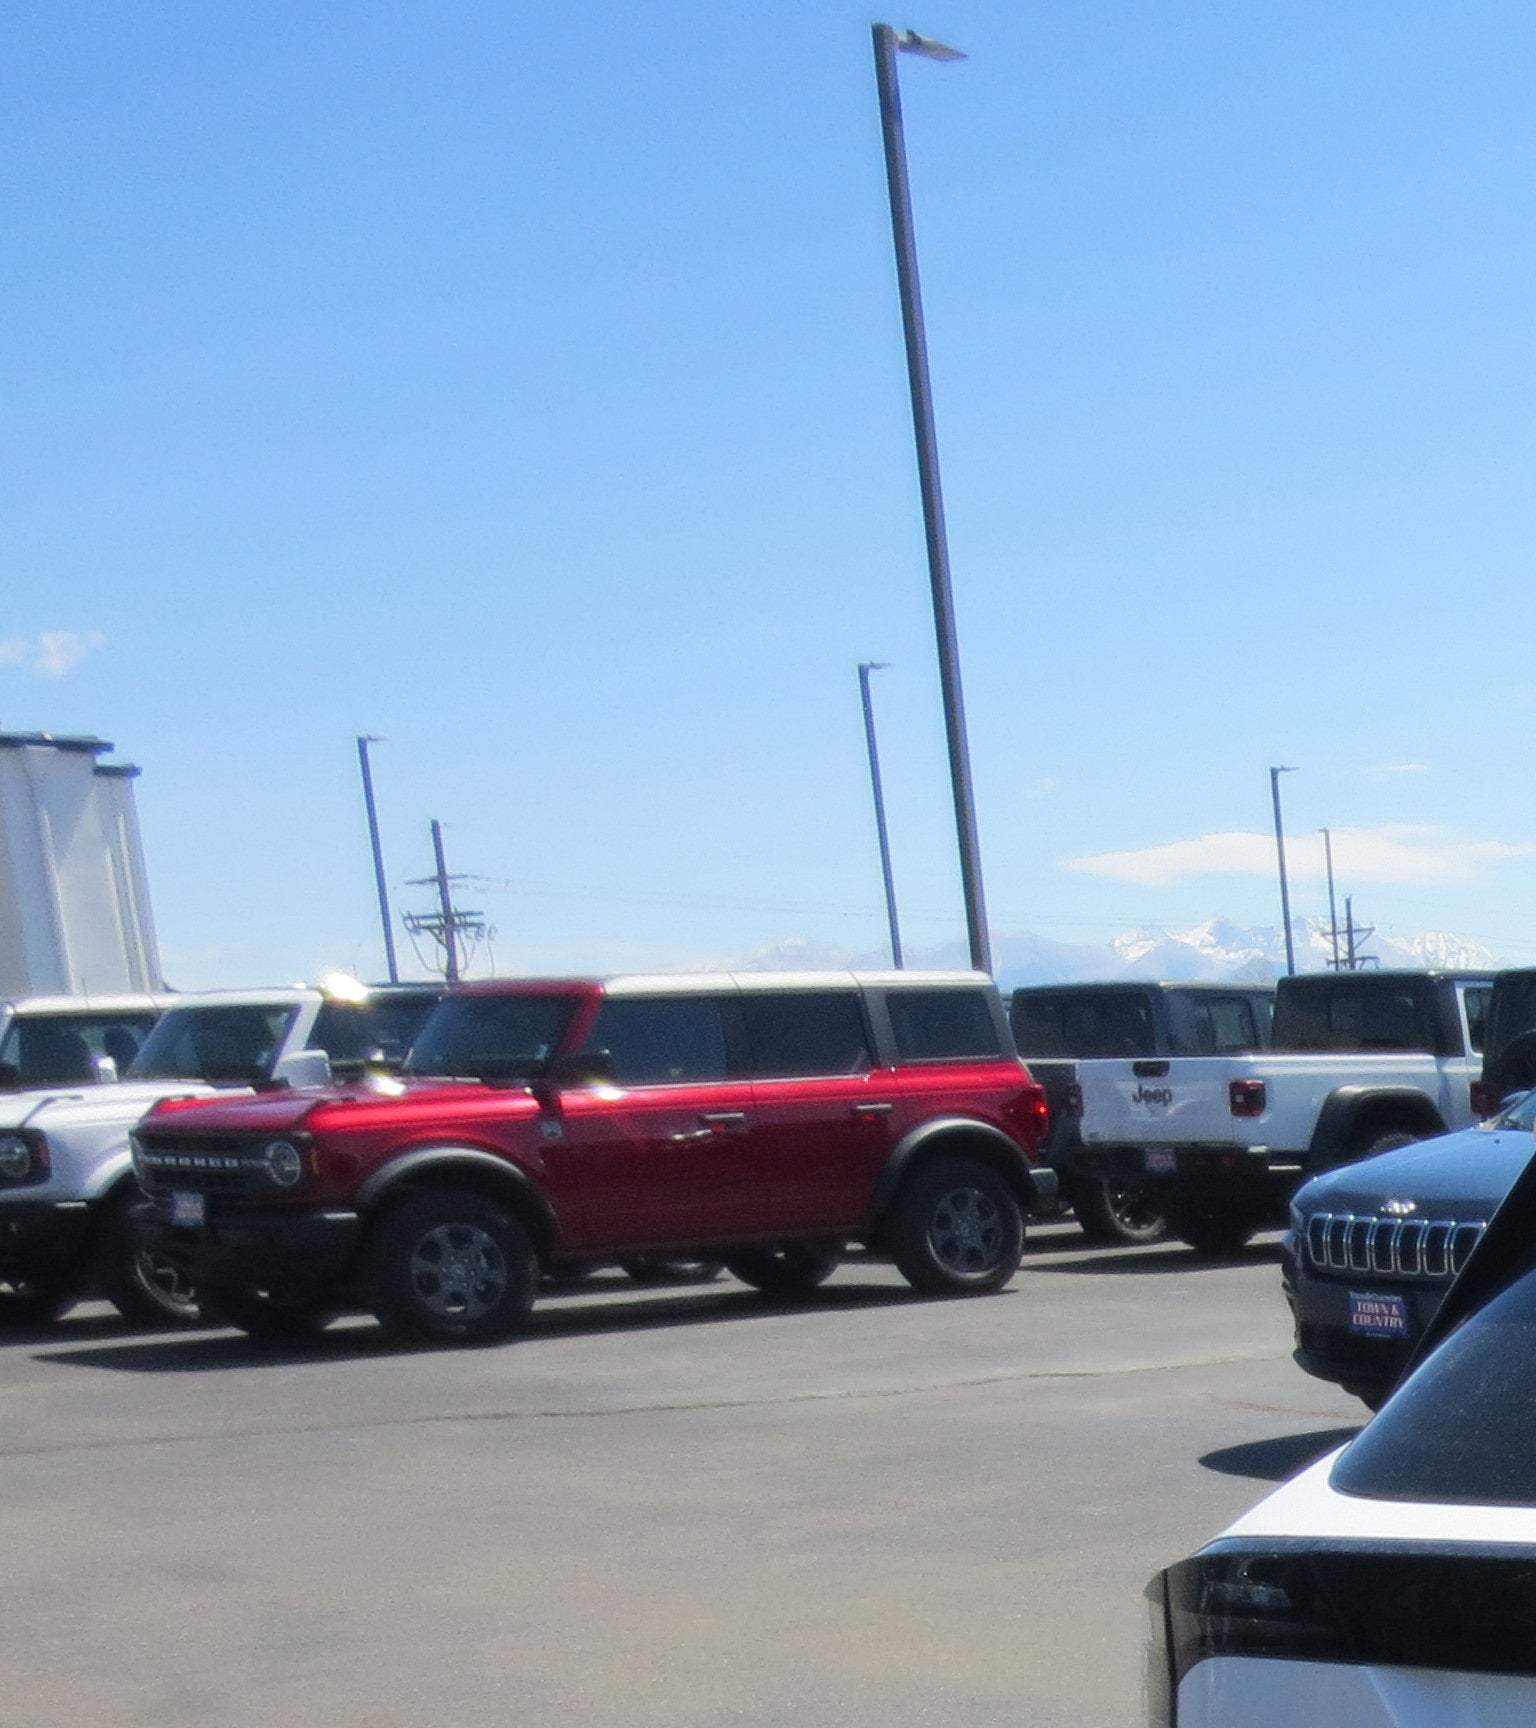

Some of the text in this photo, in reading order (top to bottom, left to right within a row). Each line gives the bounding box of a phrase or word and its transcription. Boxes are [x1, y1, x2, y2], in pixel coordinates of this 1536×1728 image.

[1132, 1083, 1173, 1107] Jeep
[1356, 1301, 1401, 1316] TOWN &
[1353, 1313, 1404, 1329] COUNTRY
